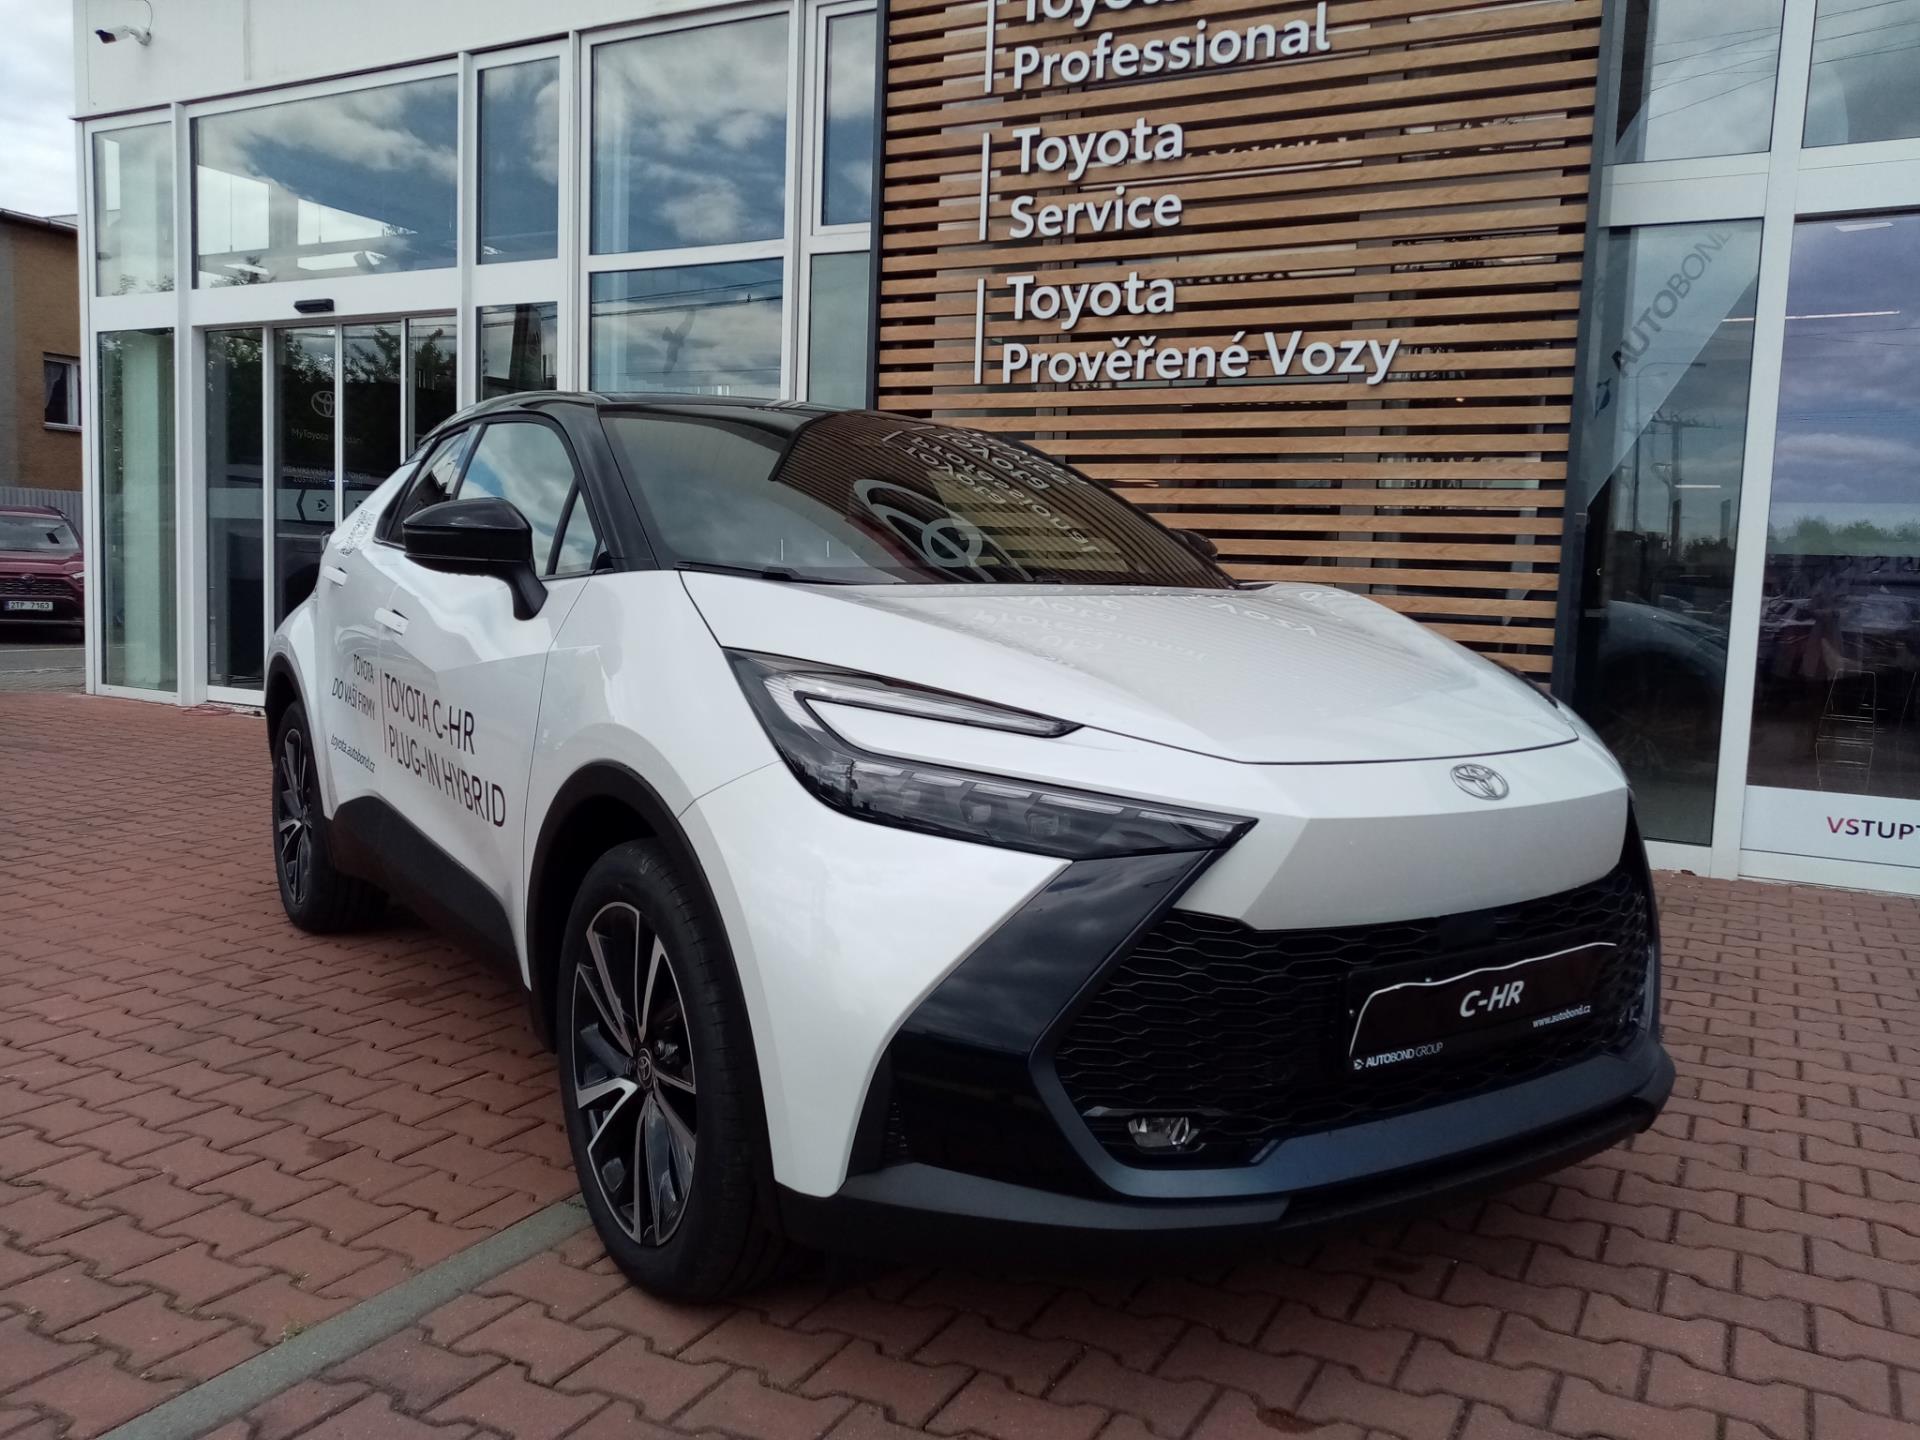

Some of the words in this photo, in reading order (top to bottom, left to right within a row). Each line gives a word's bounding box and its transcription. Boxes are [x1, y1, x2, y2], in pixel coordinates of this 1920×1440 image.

[1013, 1, 1331, 90] Professional
[1012, 117, 1184, 182] Toyota
[1009, 185, 1182, 239] Service
[1006, 271, 1175, 331] Toyota
[1002, 331, 1248, 384] Prověřené
[1264, 330, 1400, 386] Vozy
[353, 654, 375, 685] TOYOTA
[332, 678, 344, 699] DO
[358, 692, 375, 721] FIRMY
[385, 673, 431, 732] TOYOTA
[433, 699, 475, 755] C-HR
[389, 724, 441, 790] PLUG-IN
[442, 757, 506, 828] HYBRID
[1826, 816, 1920, 840] VSTUP
[1459, 980, 1525, 1018] C-HR
[1532, 1005, 1591, 1028] www.autobond.cz
[1365, 1048, 1414, 1068] AUTOBOND
[1415, 1041, 1443, 1058] GROUP
